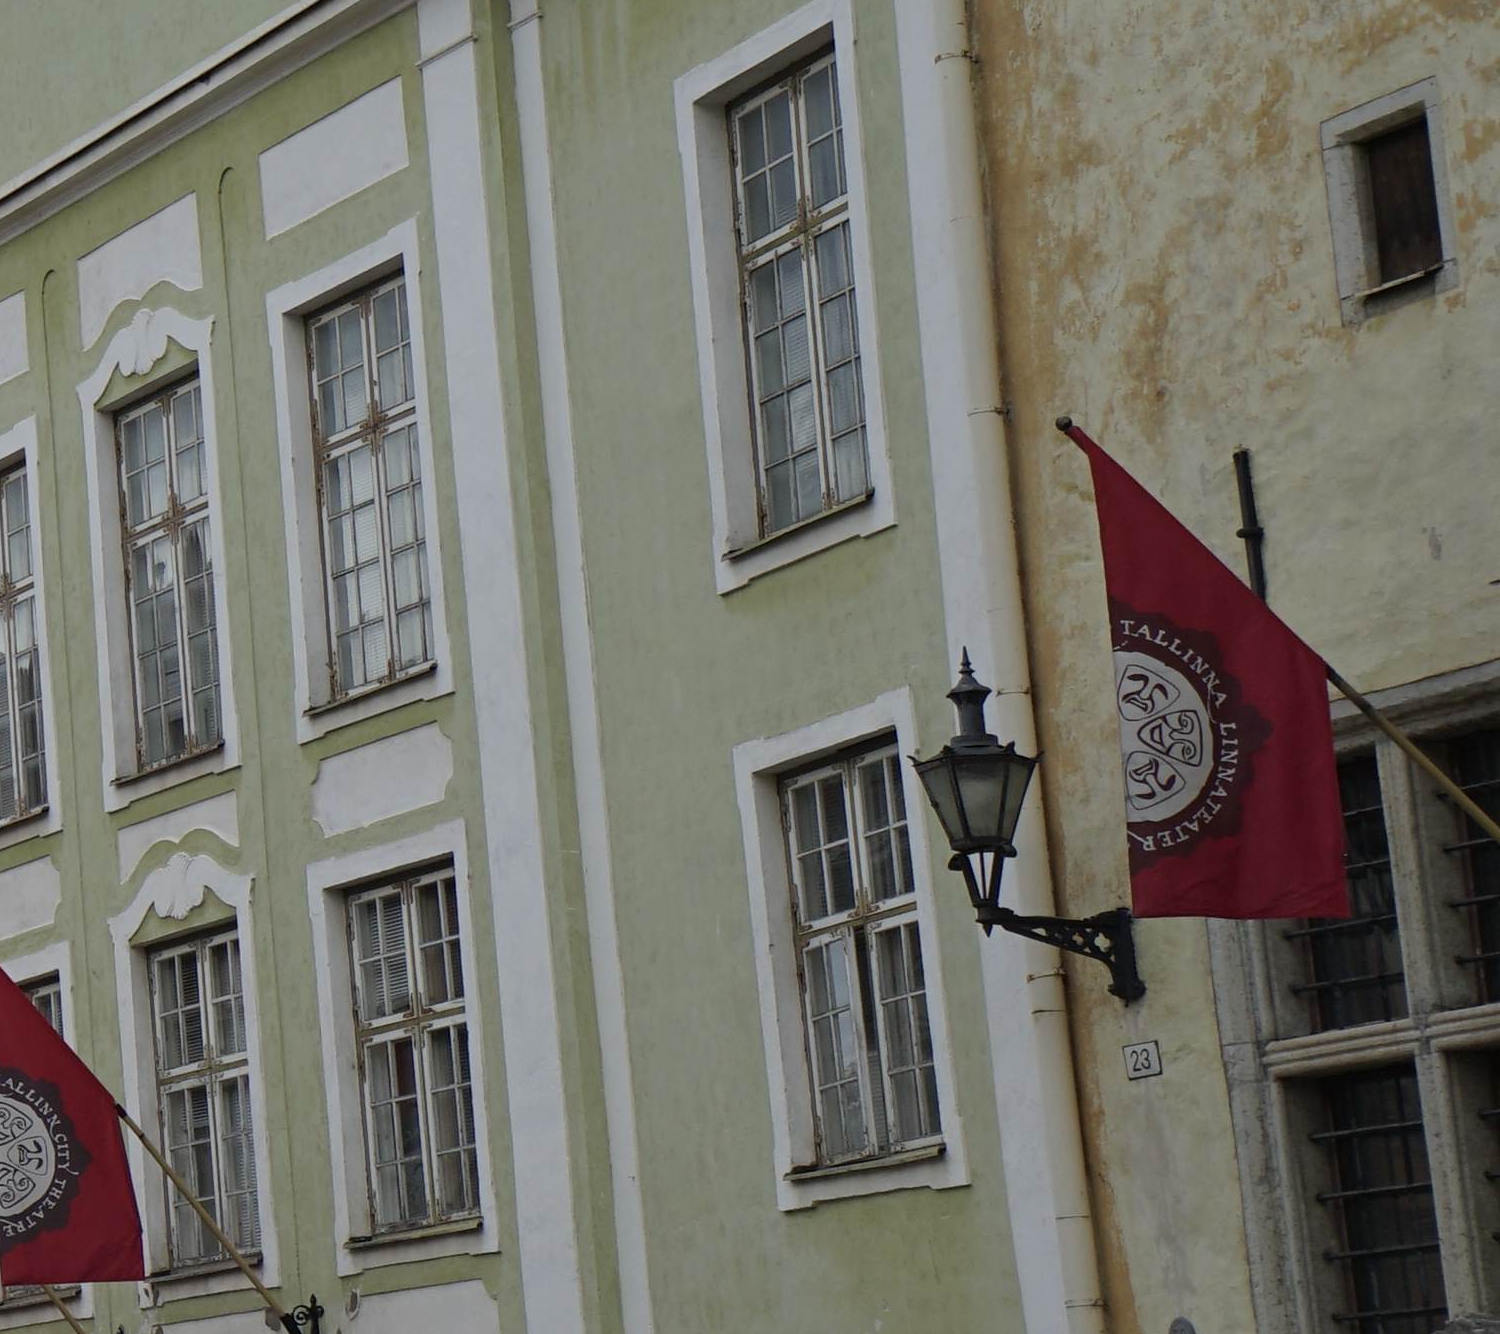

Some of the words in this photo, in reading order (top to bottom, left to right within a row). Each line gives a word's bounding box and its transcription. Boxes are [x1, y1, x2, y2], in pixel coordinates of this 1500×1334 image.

[1119, 619, 1227, 709] TALLINNA
[1139, 722, 1238, 852] LINNATEATER
[1130, 1048, 1151, 1072] 23
[54, 1133, 79, 1175] CITY
[3, 1178, 66, 1237] THEATRE
